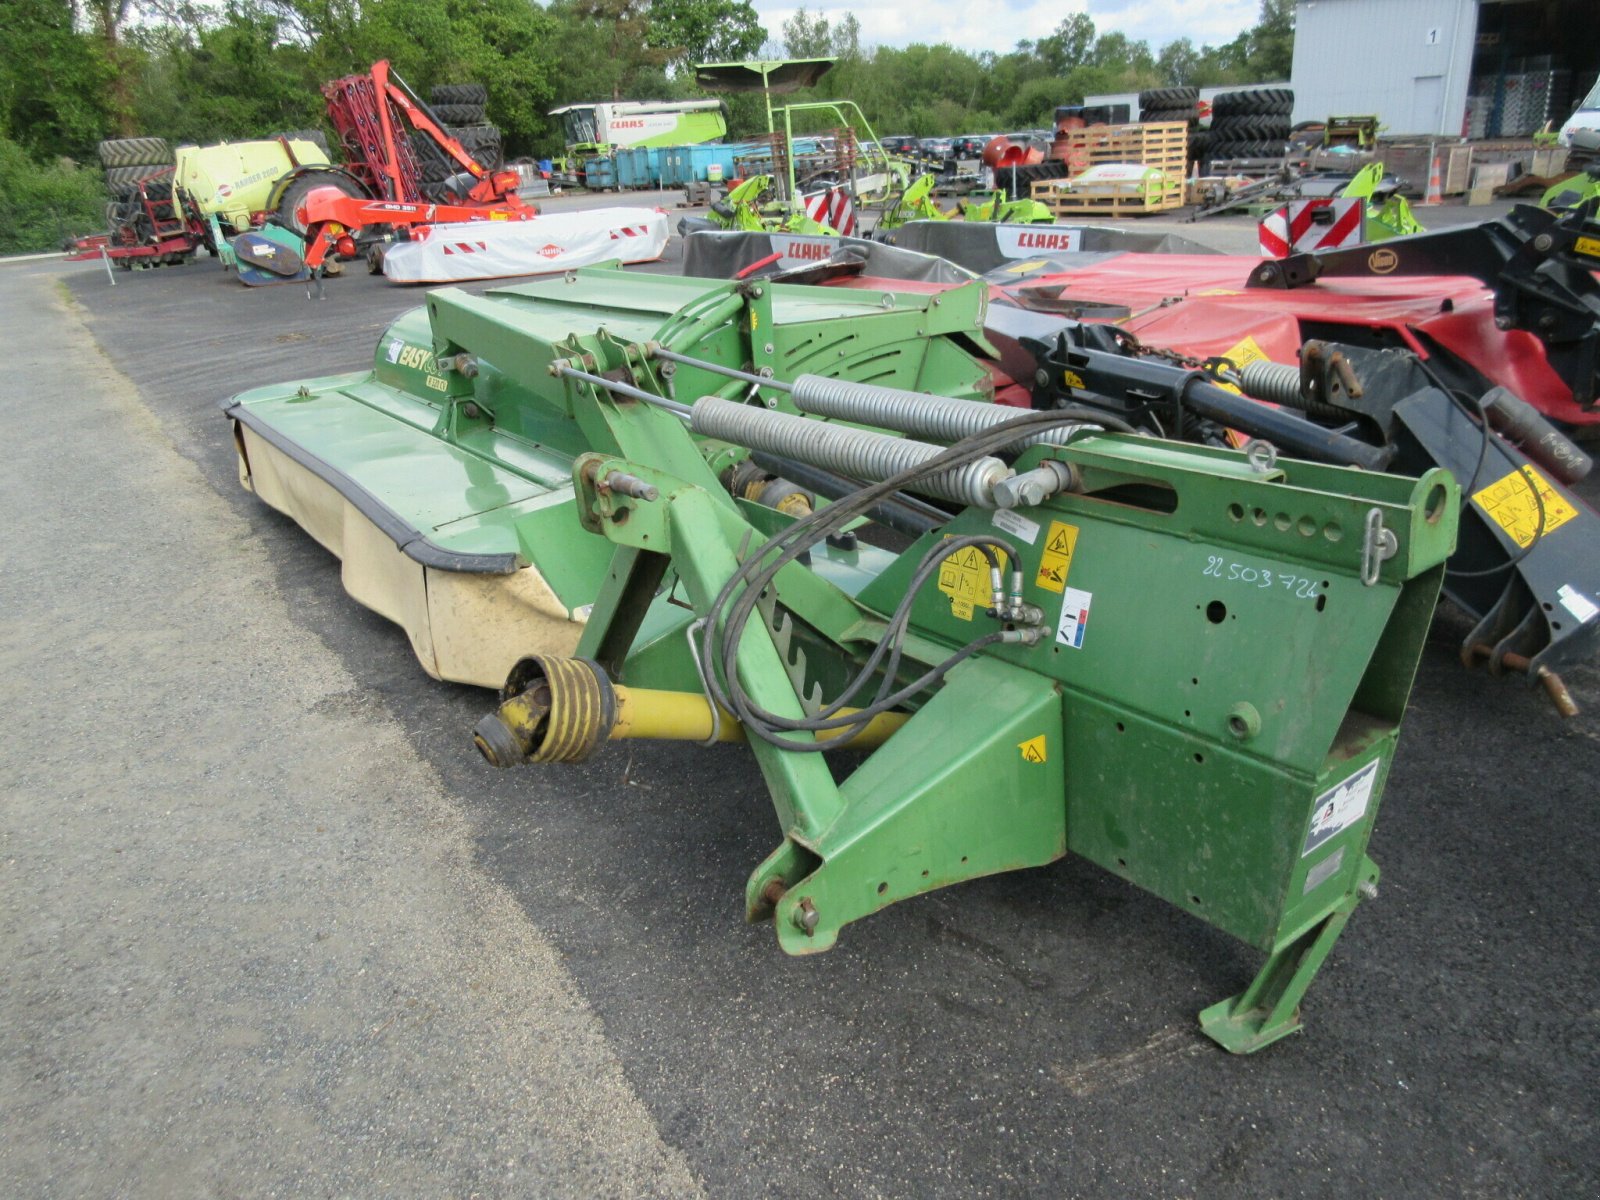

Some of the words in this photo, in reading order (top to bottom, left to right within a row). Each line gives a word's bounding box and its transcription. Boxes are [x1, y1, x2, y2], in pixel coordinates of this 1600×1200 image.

[1430, 29, 1437, 43] 1
[610, 120, 644, 129] CLAAS
[1018, 232, 1070, 250] CLAAS
[788, 242, 831, 261] CLAAS
[1228, 563, 1271, 588] 503
